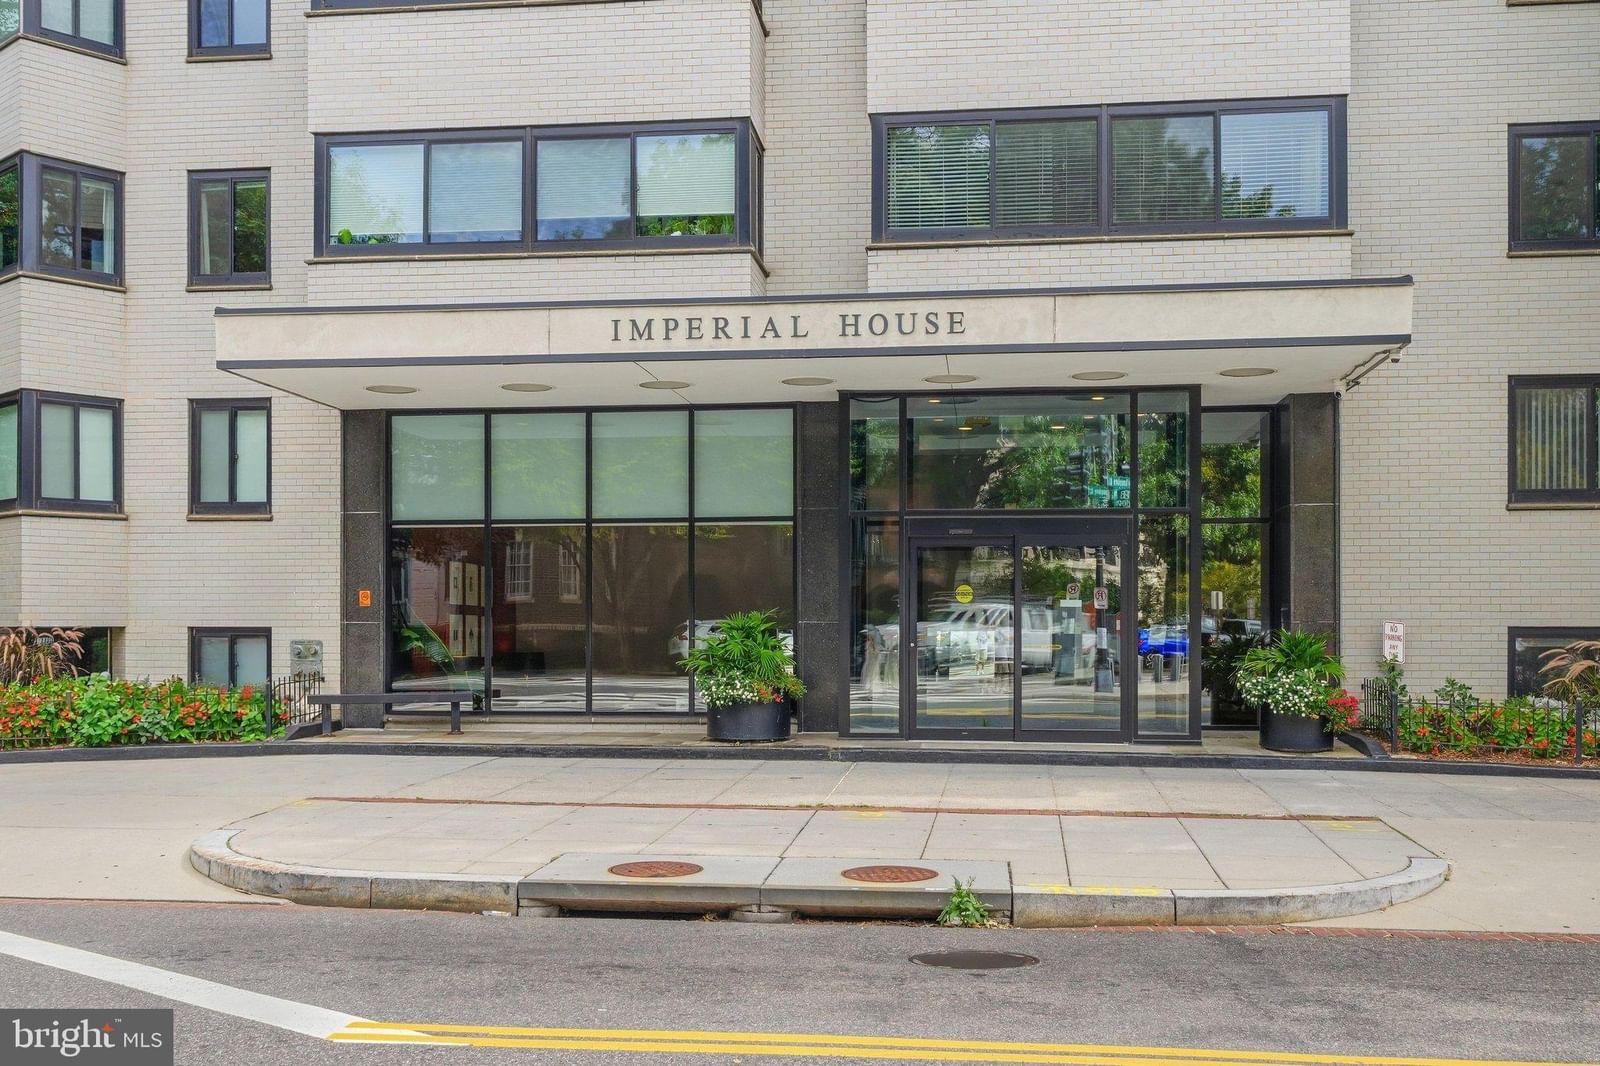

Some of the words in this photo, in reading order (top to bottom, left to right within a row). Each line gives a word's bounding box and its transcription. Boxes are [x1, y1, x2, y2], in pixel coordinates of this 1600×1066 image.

[611, 315, 809, 341] IMPERIAL
[839, 311, 966, 336] HOUSE
[1390, 625, 1398, 633] NO
